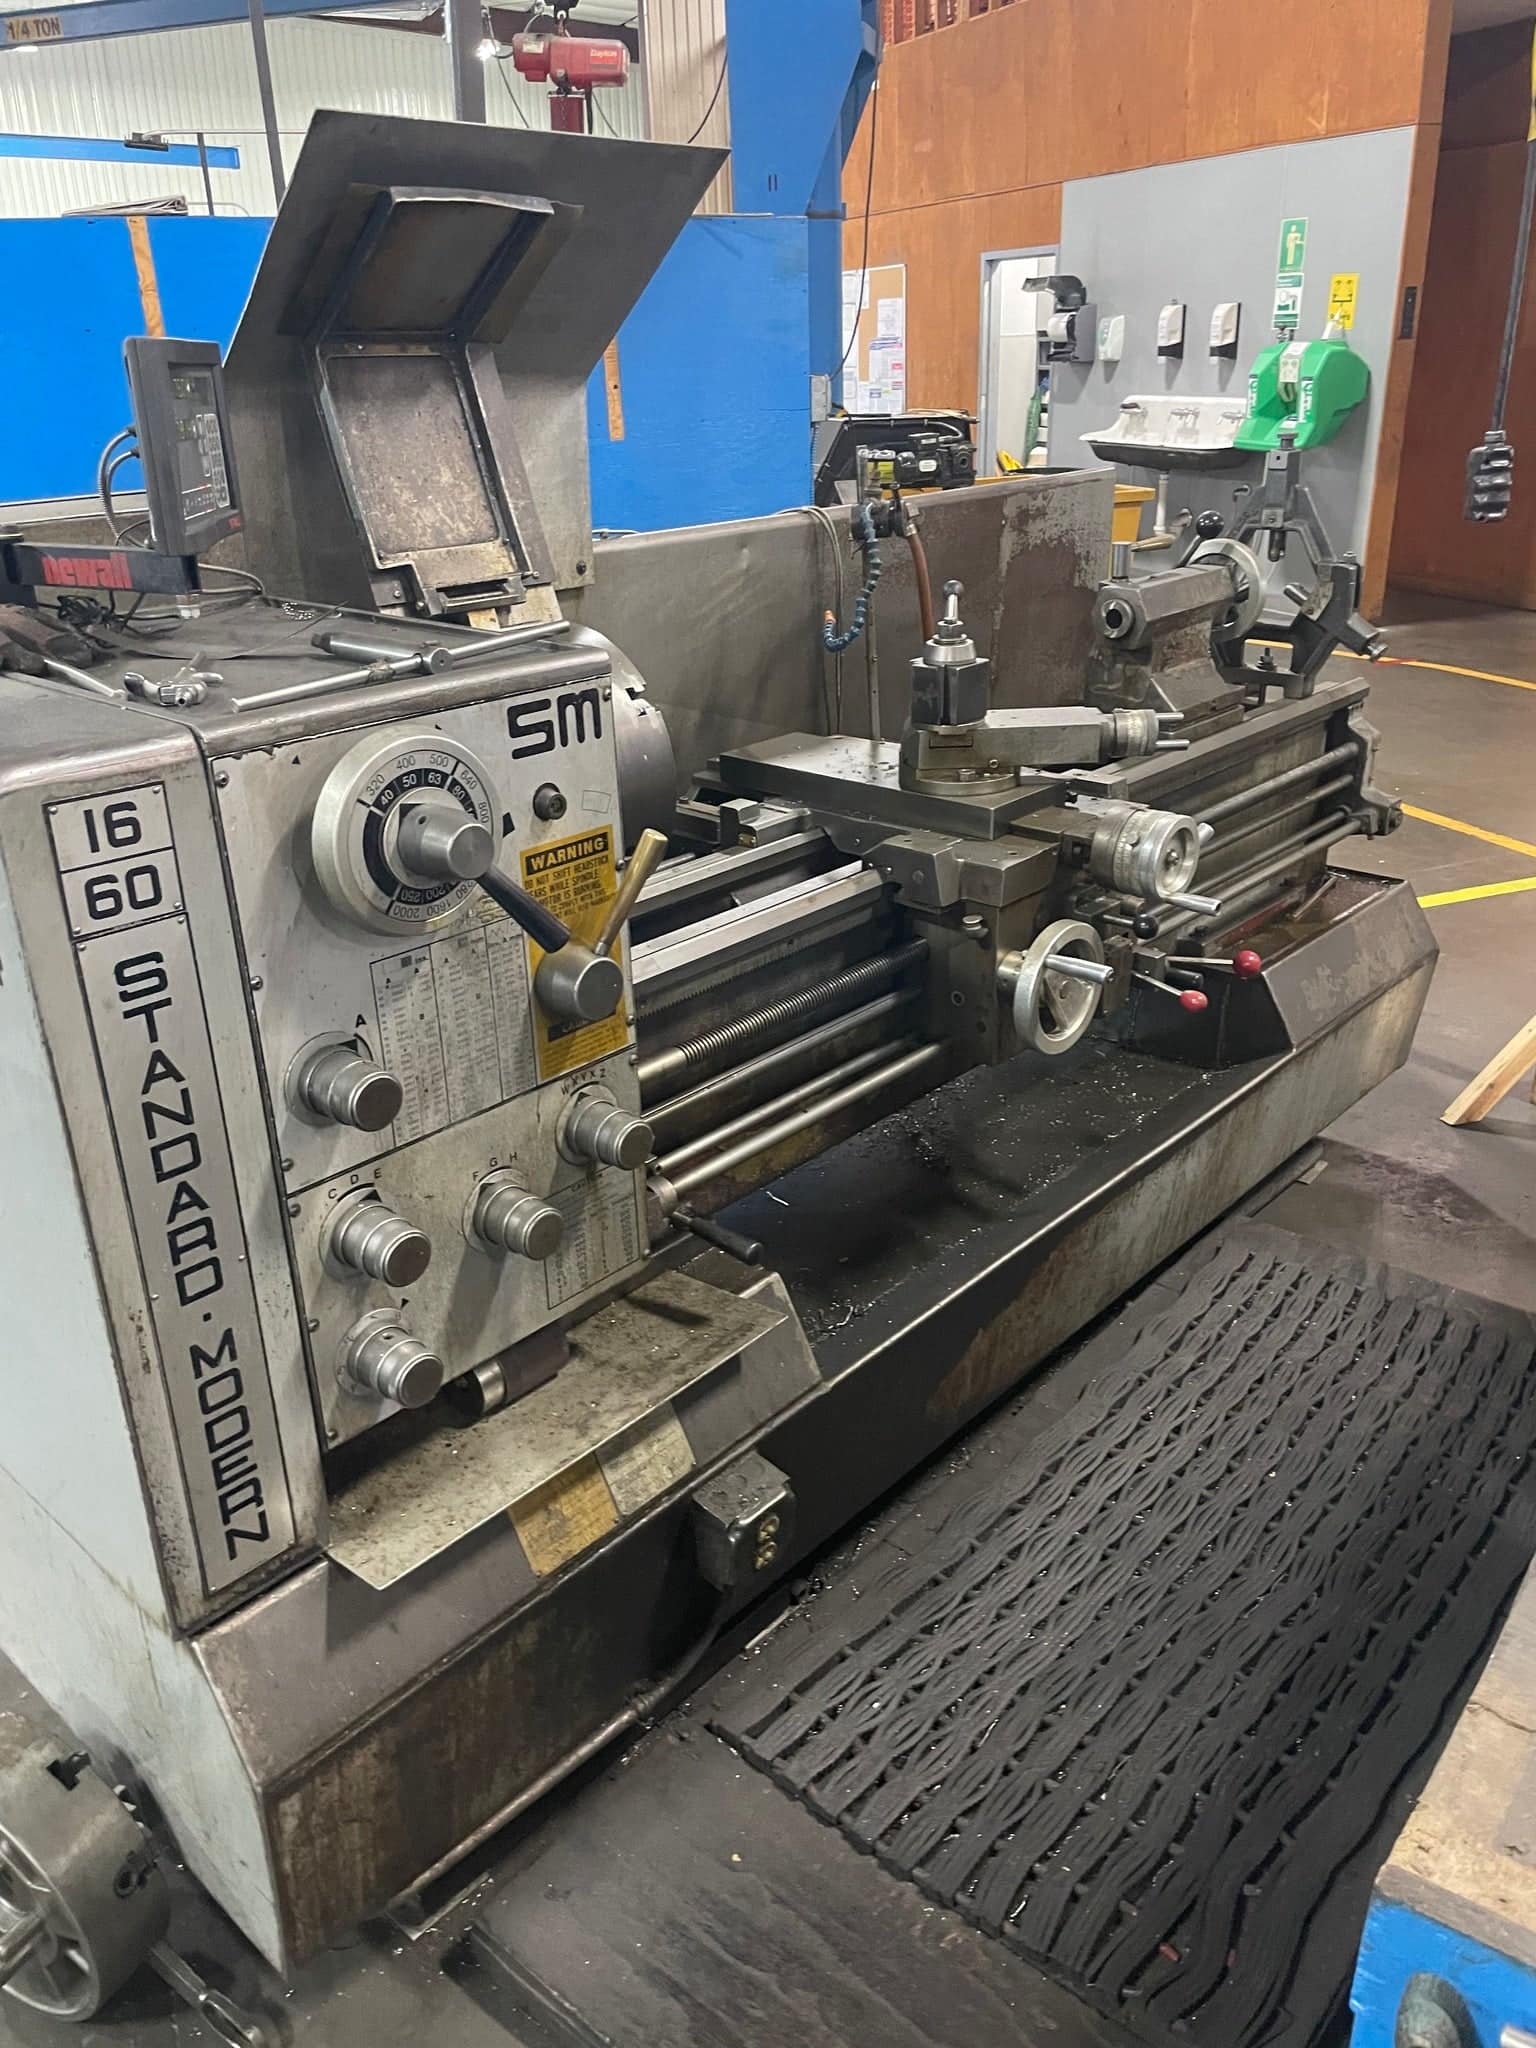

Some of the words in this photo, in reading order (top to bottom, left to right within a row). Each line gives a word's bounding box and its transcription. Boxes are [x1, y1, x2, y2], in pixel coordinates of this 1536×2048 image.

[9, 21, 31, 40] 1/4
[33, 17, 61, 38] TON
[366, 774, 385, 797] 320
[397, 755, 416, 770] 400
[429, 753, 449, 768] 500
[460, 771, 477, 790] 640
[479, 801, 489, 824] 800
[380, 789, 395, 806] 40
[402, 773, 417, 788] 50
[427, 772, 443, 784] 63
[452, 784, 466, 801] 80
[83, 801, 142, 853] 16
[530, 837, 605, 871] WARNING
[84, 864, 163, 920] 60
[401, 888, 421, 903] 250
[393, 905, 420, 919] 2000
[355, 1013, 367, 1028] A
[113, 951, 224, 1307] STANDARD
[472, 1171, 479, 1182] F
[489, 1157, 498, 1167] G
[509, 1151, 517, 1161] H
[328, 1188, 337, 1200] C
[350, 1174, 359, 1185] D
[374, 1168, 382, 1179] E
[189, 1327, 270, 1561] MODERN
